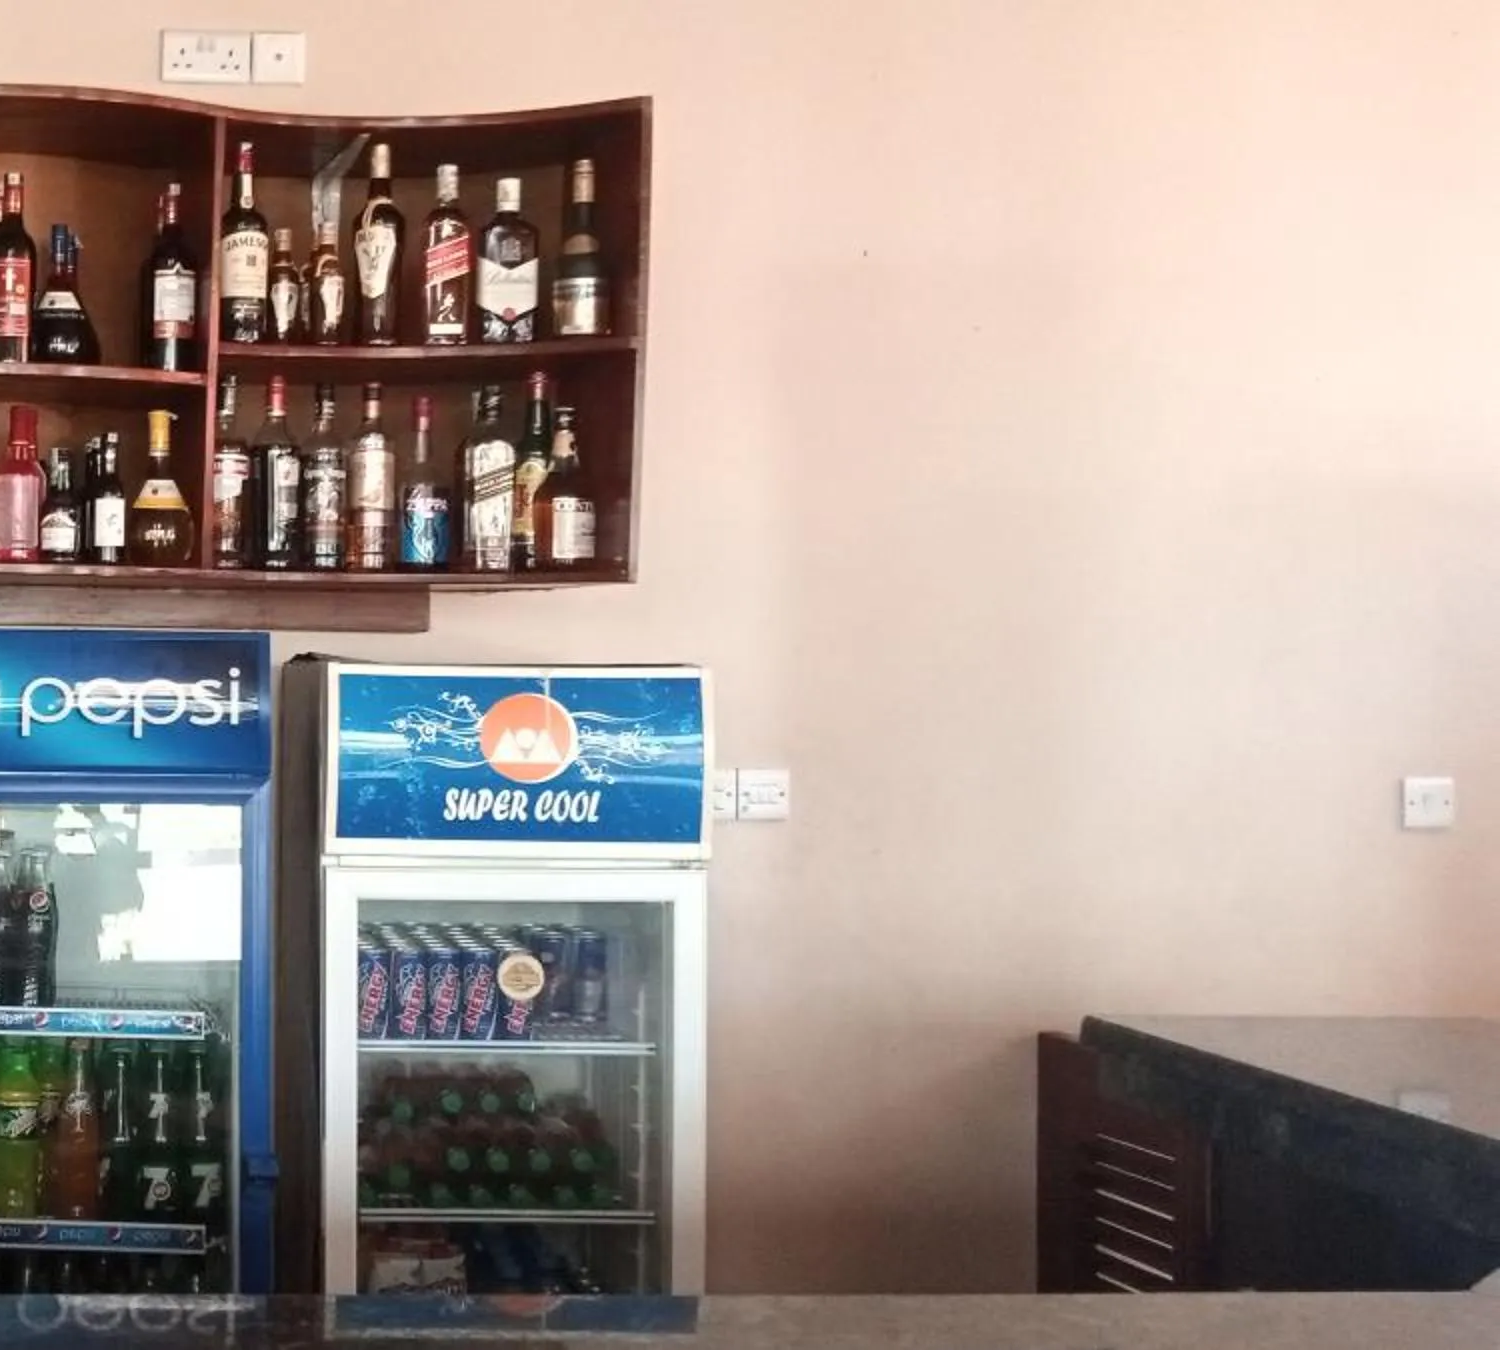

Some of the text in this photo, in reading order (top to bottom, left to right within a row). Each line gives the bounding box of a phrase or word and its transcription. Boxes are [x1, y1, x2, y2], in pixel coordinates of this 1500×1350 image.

[21, 667, 241, 738] pepsi
[443, 787, 601, 822] SUPER COOL
